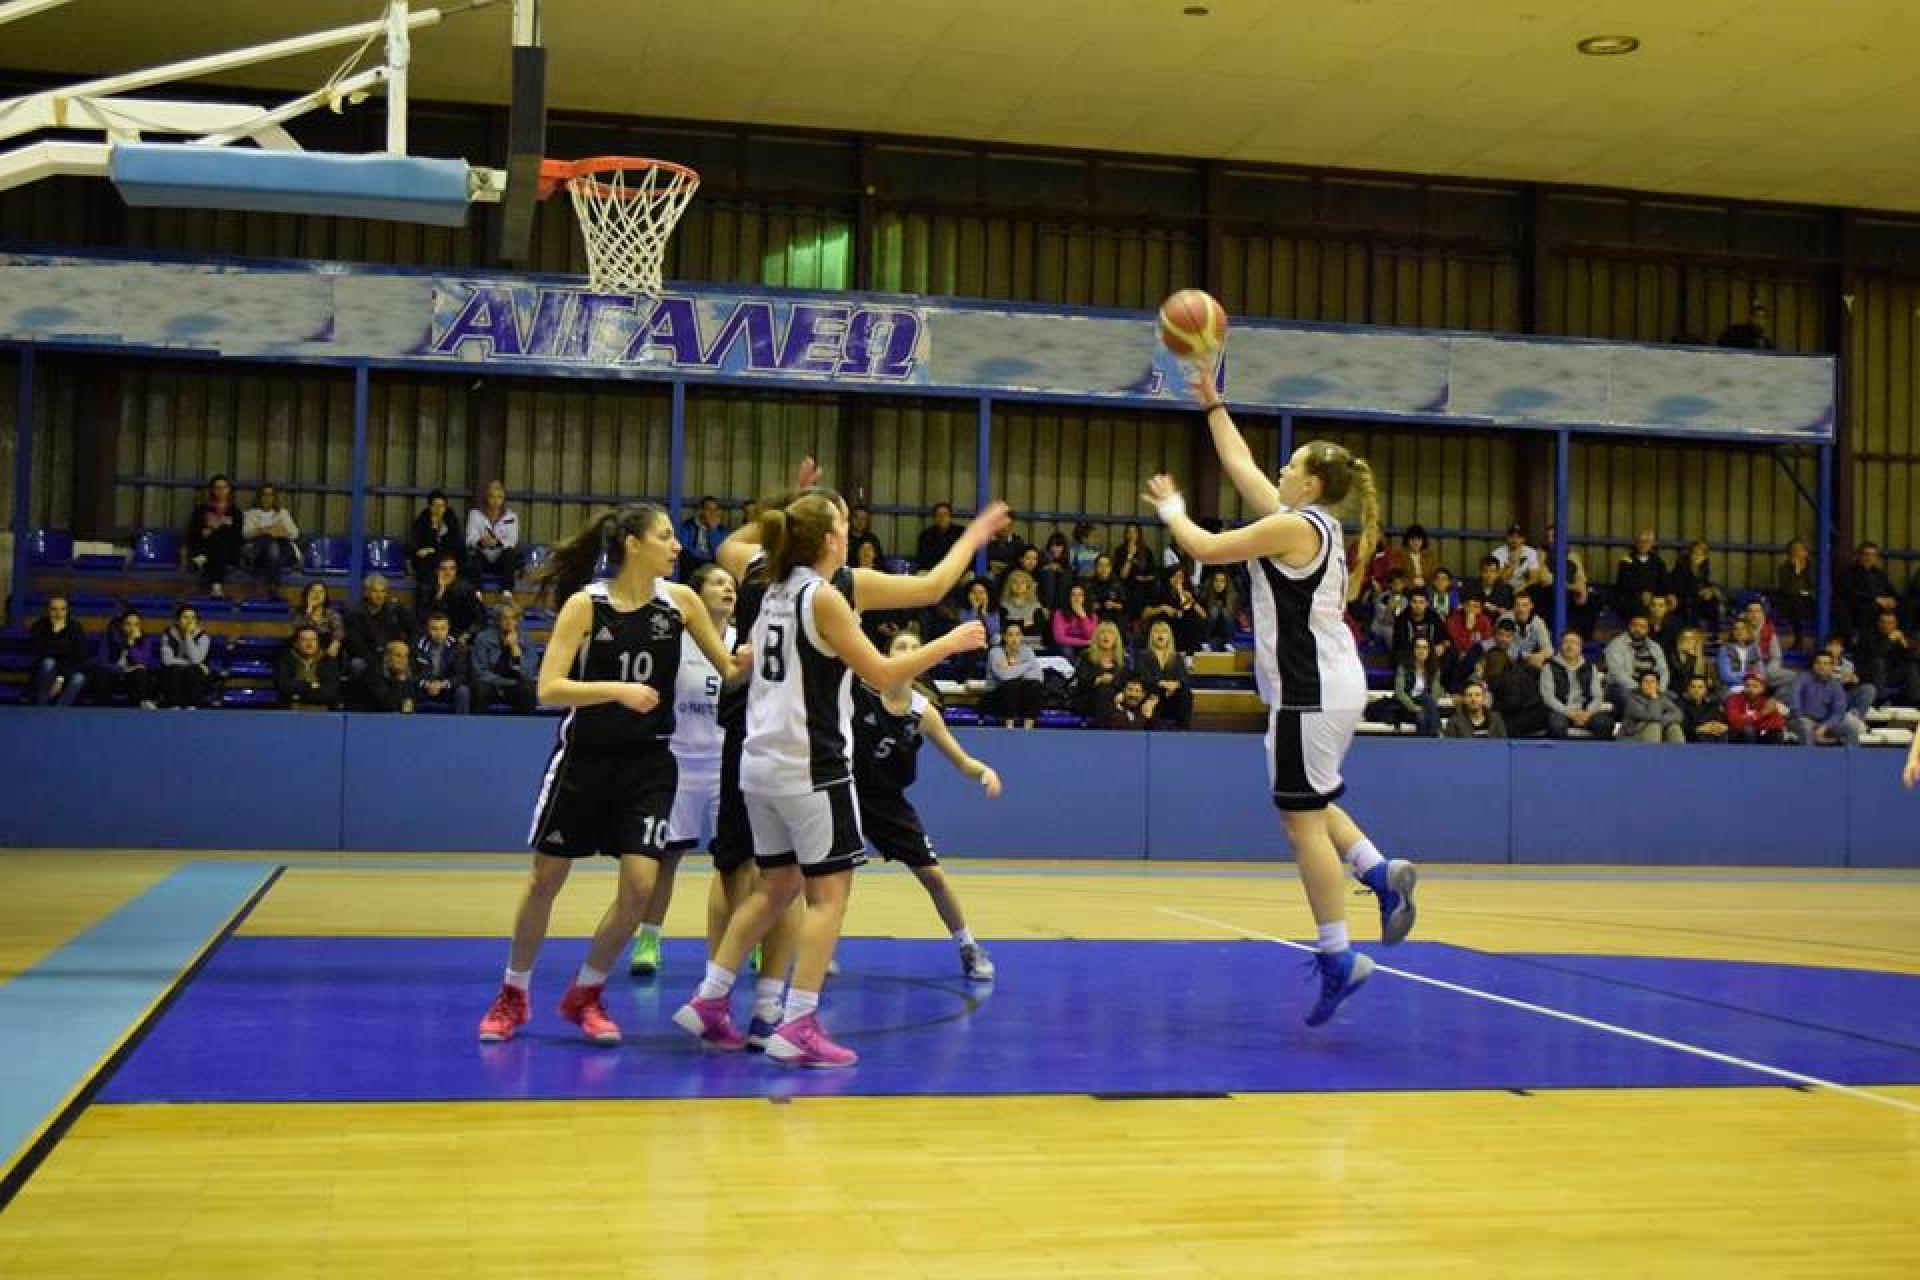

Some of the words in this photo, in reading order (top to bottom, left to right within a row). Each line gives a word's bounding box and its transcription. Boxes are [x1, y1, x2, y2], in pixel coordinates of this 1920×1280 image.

[433, 287, 921, 379] ΑΙΓΑΛΕΩ
[619, 652, 653, 682] 10
[761, 624, 785, 682] 8
[704, 676, 719, 696] 5
[874, 737, 897, 759] 5
